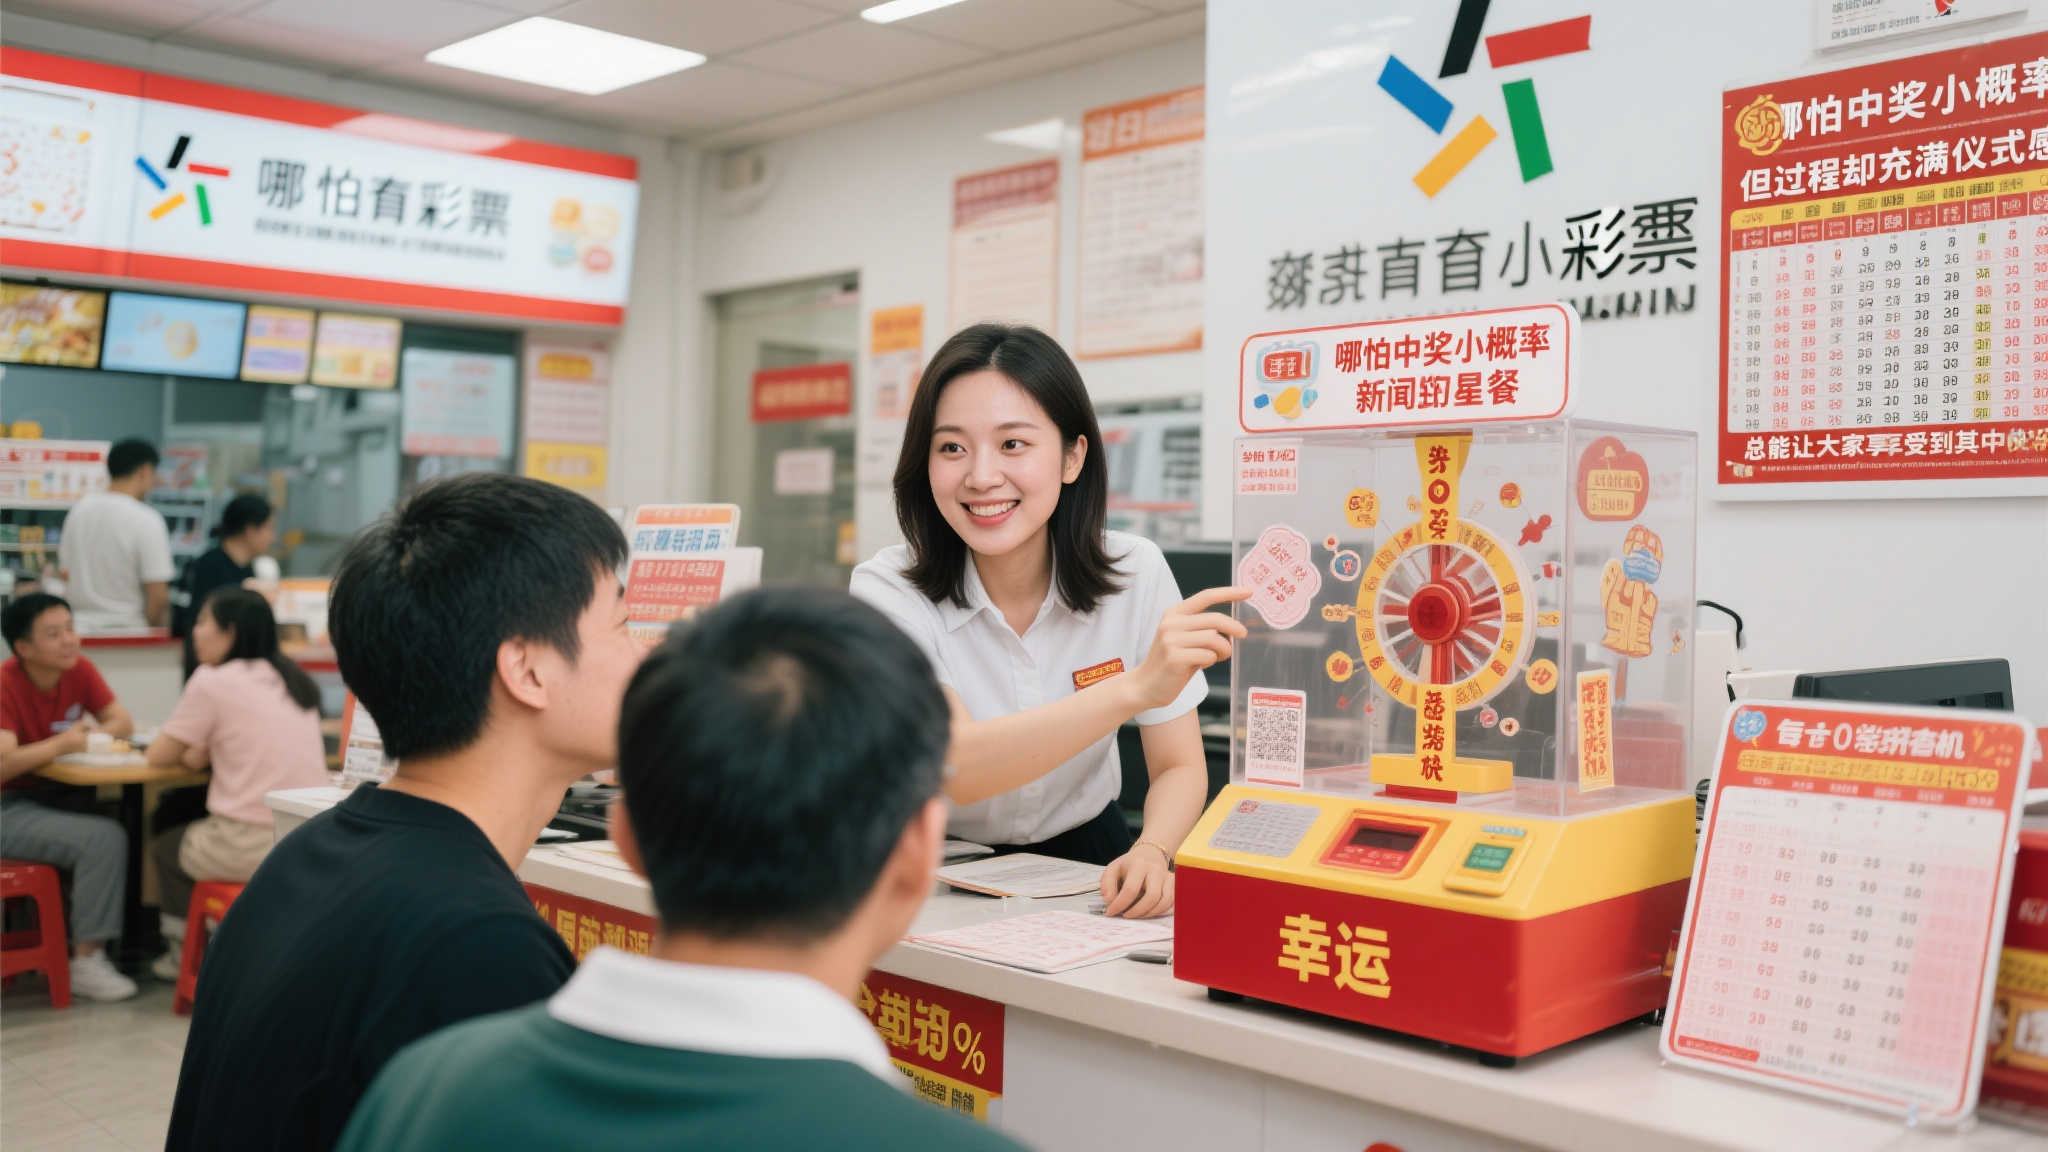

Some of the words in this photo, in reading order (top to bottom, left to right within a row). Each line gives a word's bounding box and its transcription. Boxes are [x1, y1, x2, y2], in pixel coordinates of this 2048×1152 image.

[1335, 322, 1550, 373] 哪怕中奖小概率
[1278, 913, 1391, 998] 幸运
